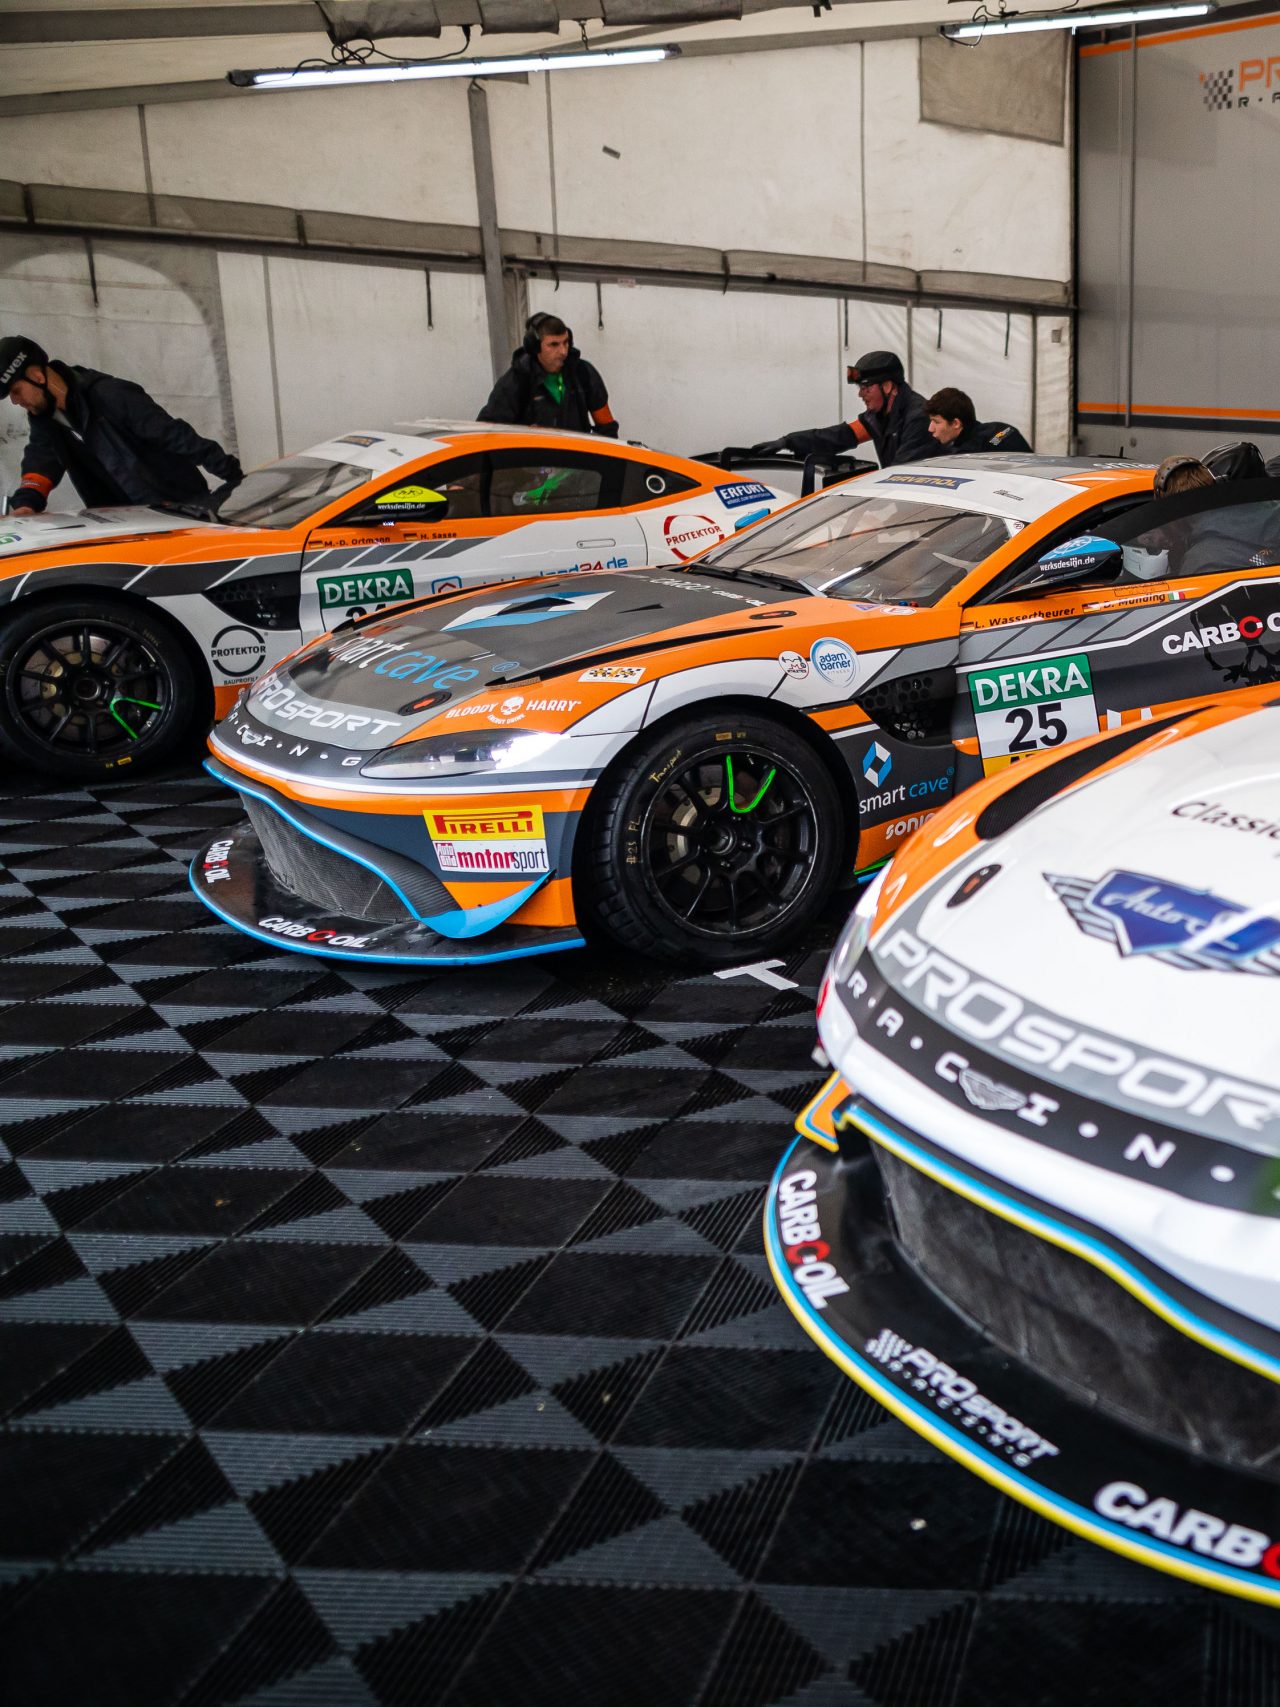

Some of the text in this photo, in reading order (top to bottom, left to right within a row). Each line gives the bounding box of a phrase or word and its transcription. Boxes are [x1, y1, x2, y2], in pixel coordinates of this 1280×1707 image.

[0, 351, 28, 384] uvex
[720, 484, 765, 499] ERFURT
[351, 536, 390, 545] Ortmann
[432, 531, 457, 539] Sasse
[665, 525, 722, 546] PROTEKTOR
[1039, 556, 1096, 571] werksdesign.de
[323, 575, 410, 604] DEKRA
[974, 607, 1075, 629] L. Wassertheurer
[211, 645, 266, 657] PROTEKTOR
[820, 653, 847, 663] adam
[374, 651, 479, 690] cave
[819, 659, 851, 671] barner
[974, 662, 1089, 706] DEKRA
[250, 672, 402, 735] PROSPORT
[445, 700, 577, 719] BLOODY HARRY
[1005, 702, 1068, 753] 25
[859, 777, 949, 814] smart cave
[432, 810, 533, 834] PIRELLI
[457, 848, 547, 872] motorsport
[205, 868, 230, 883] OIL
[328, 936, 371, 948] OIL
[795, 1260, 850, 1311] OIL
[900, 1347, 1060, 1459] PROSPORT
